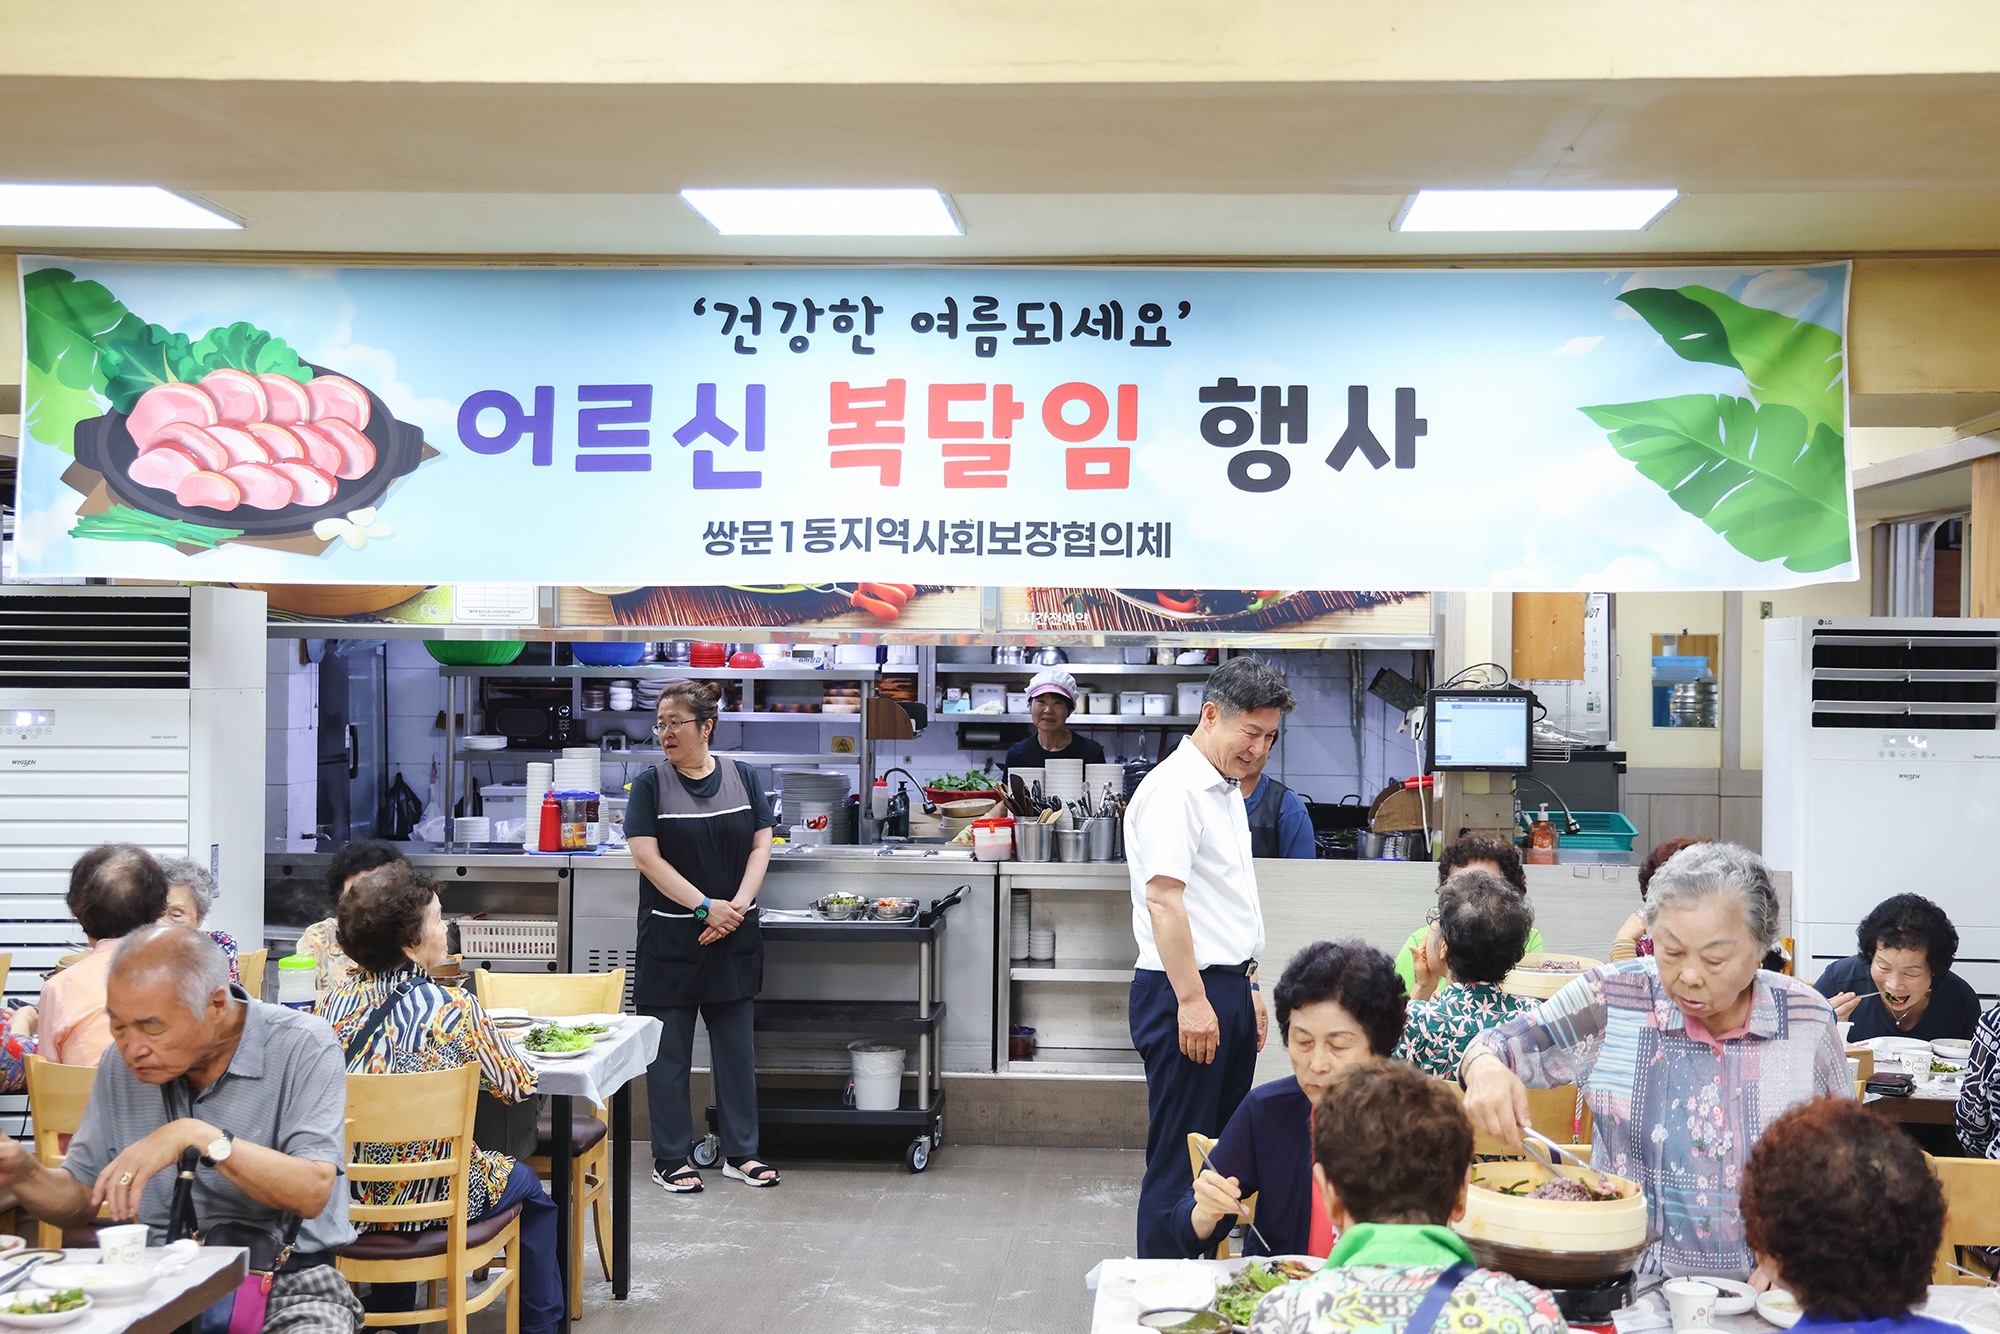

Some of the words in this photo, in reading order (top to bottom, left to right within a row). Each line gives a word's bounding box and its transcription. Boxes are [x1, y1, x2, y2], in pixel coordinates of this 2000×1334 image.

[458, 383, 765, 489] 어르신
[828, 379, 1138, 490] 복달임
[1200, 378, 1426, 492] 행사
[704, 518, 1170, 558] 쌍문1동지역사회보장협의체
[1014, 611, 1089, 626] 1시간전예약
[12, 759, 37, 767] WHISEN
